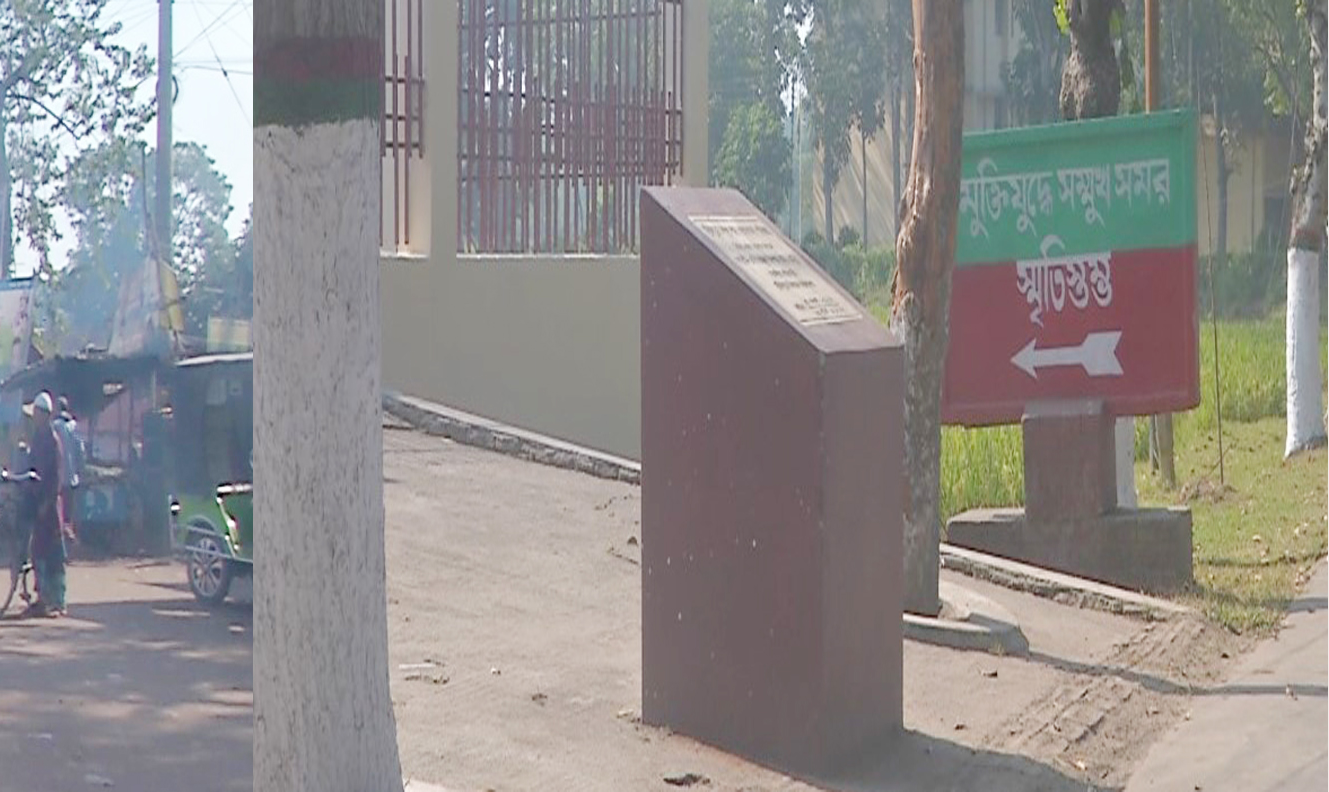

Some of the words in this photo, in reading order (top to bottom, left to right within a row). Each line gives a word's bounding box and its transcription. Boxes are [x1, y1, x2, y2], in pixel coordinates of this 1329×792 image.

[959, 158, 1053, 238] মুক্তিযুদ্ধে
[1057, 164, 1110, 228] সম্মুখ
[1114, 158, 1171, 206] সমর
[1016, 234, 1113, 327] স্মৃতিস্তম্ভ
